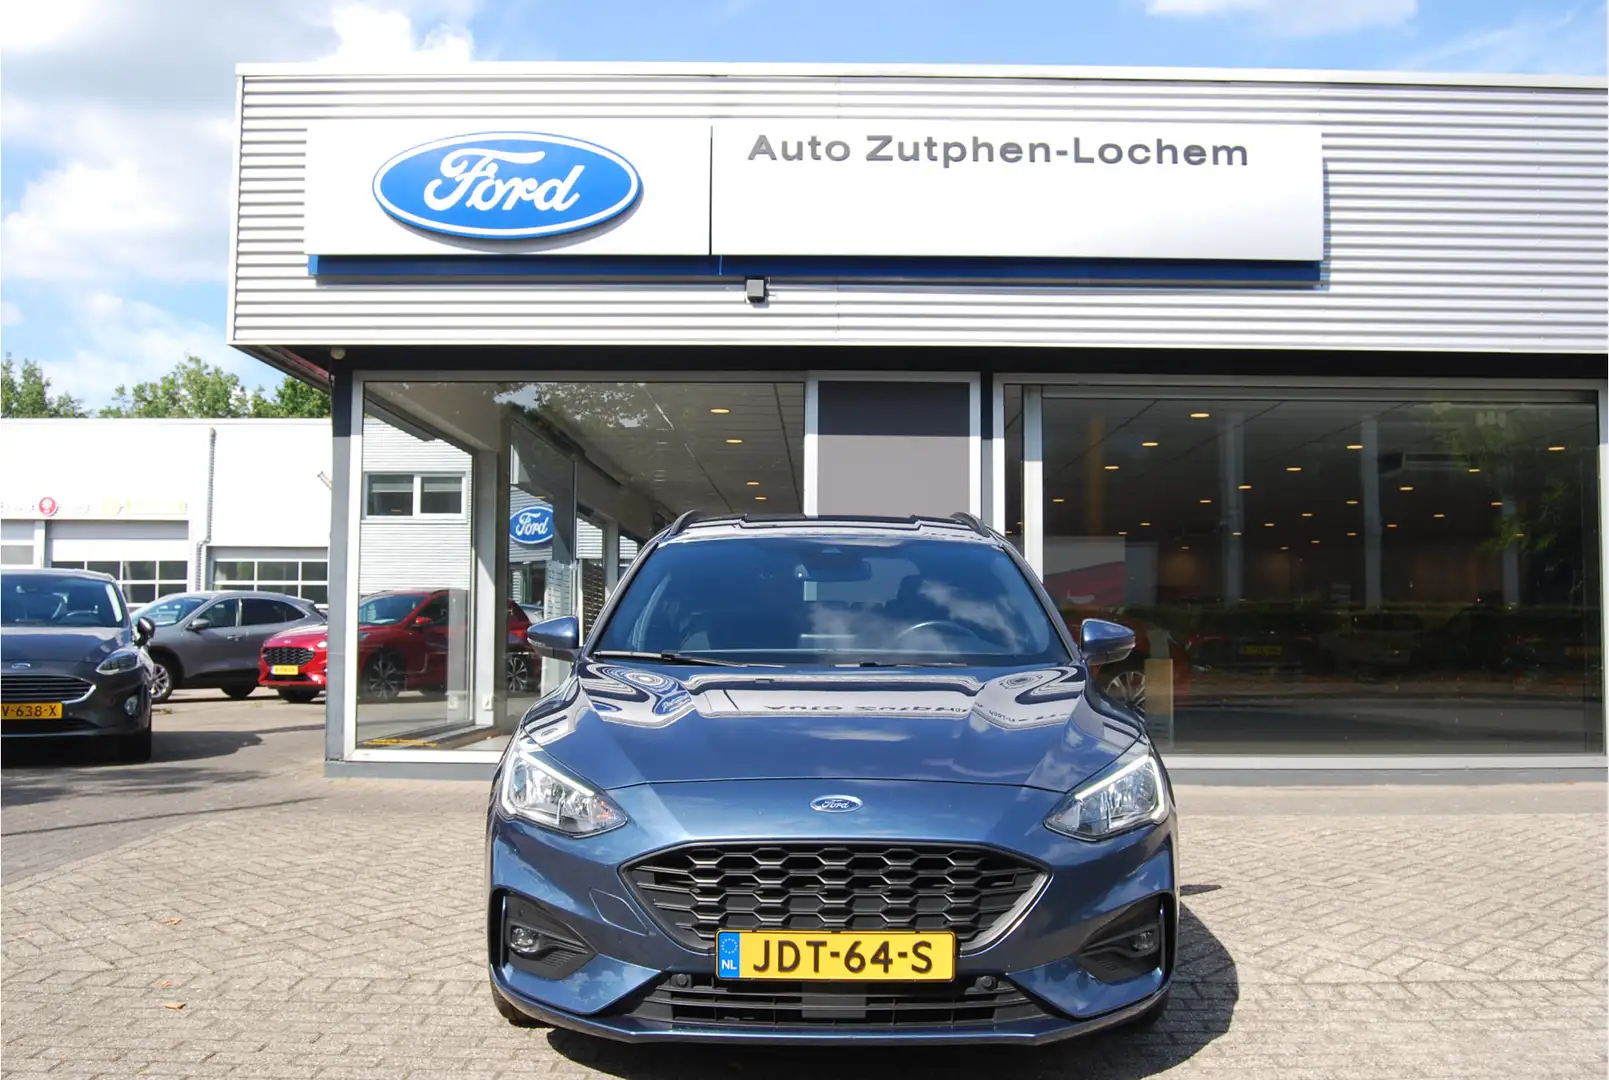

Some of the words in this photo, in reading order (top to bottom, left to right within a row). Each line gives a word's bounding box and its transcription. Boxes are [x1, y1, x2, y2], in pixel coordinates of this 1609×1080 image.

[747, 134, 851, 162] Auto
[865, 134, 1248, 168] Zutphen-Lochem
[423, 147, 585, 211] Ford
[515, 511, 549, 537] Ford
[721, 959, 737, 971] NL
[753, 940, 933, 973] JDT-64-S
